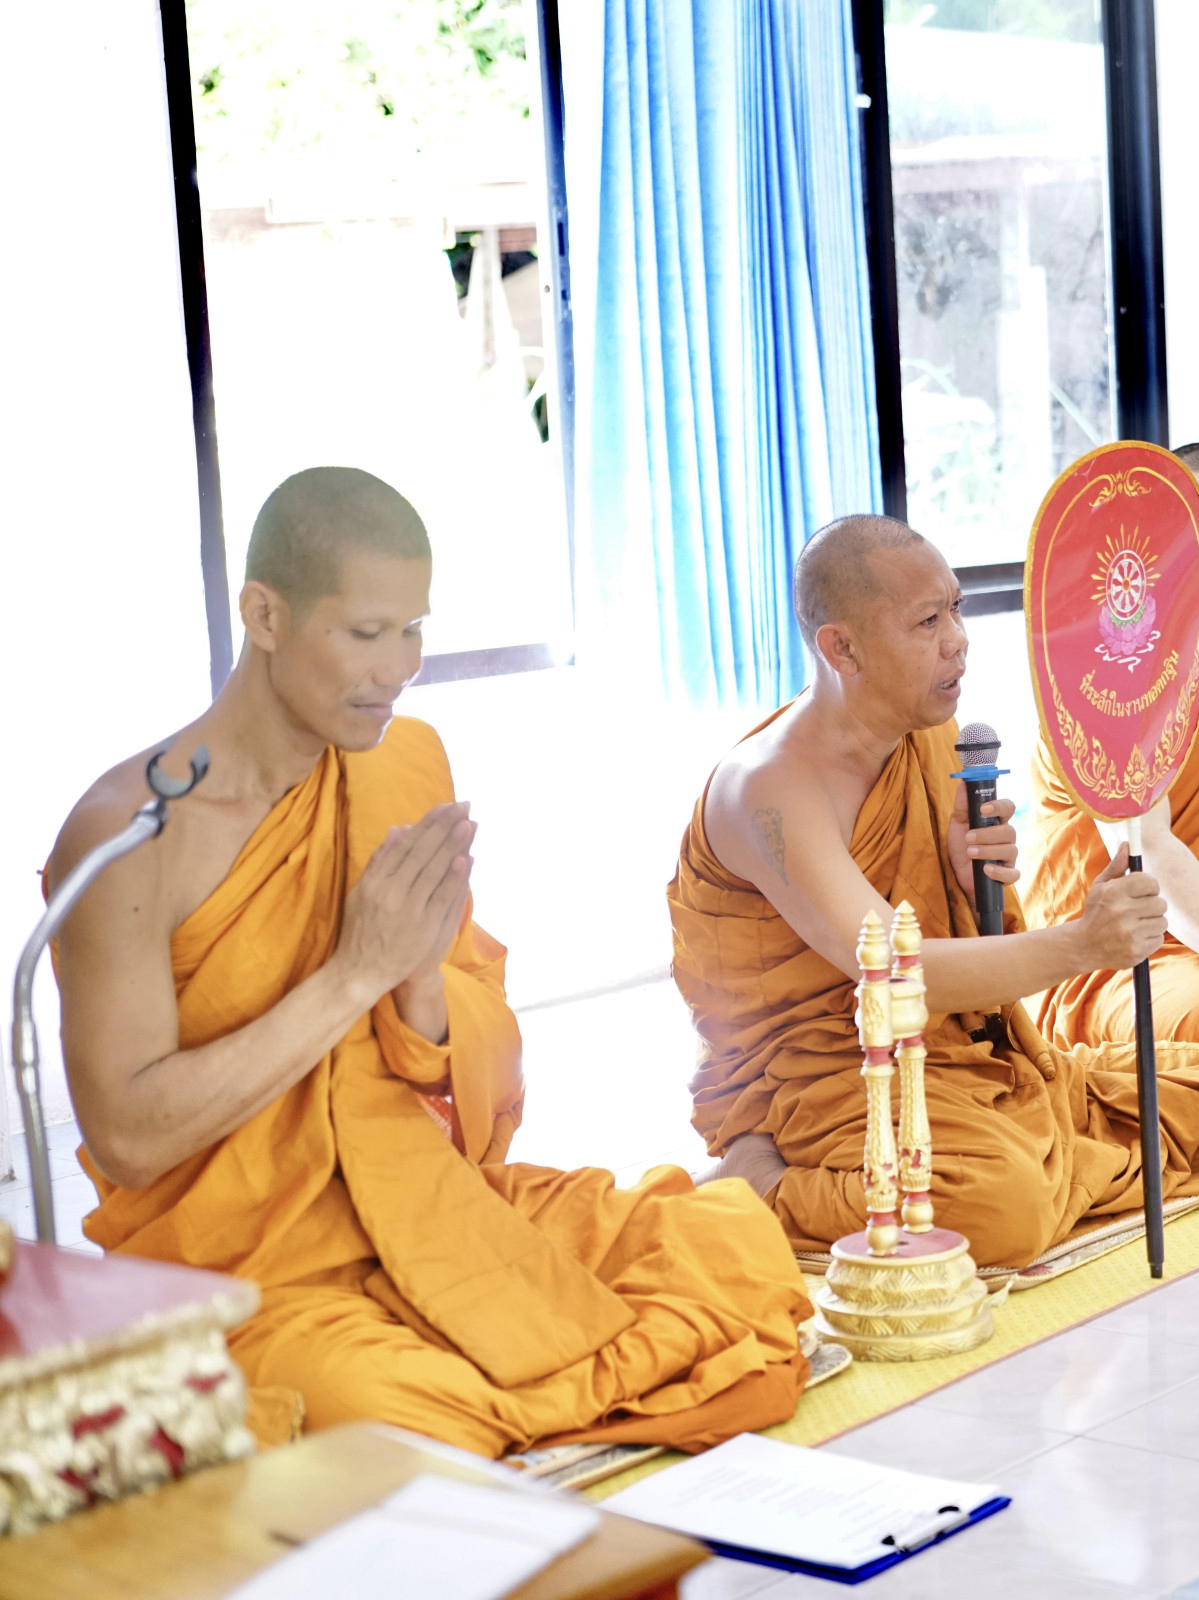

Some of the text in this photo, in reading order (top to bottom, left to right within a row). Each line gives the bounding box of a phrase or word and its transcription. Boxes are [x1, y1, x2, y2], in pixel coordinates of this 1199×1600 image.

[1079, 649, 1179, 717] ที่ระลึกในงานทอดกฐิน
